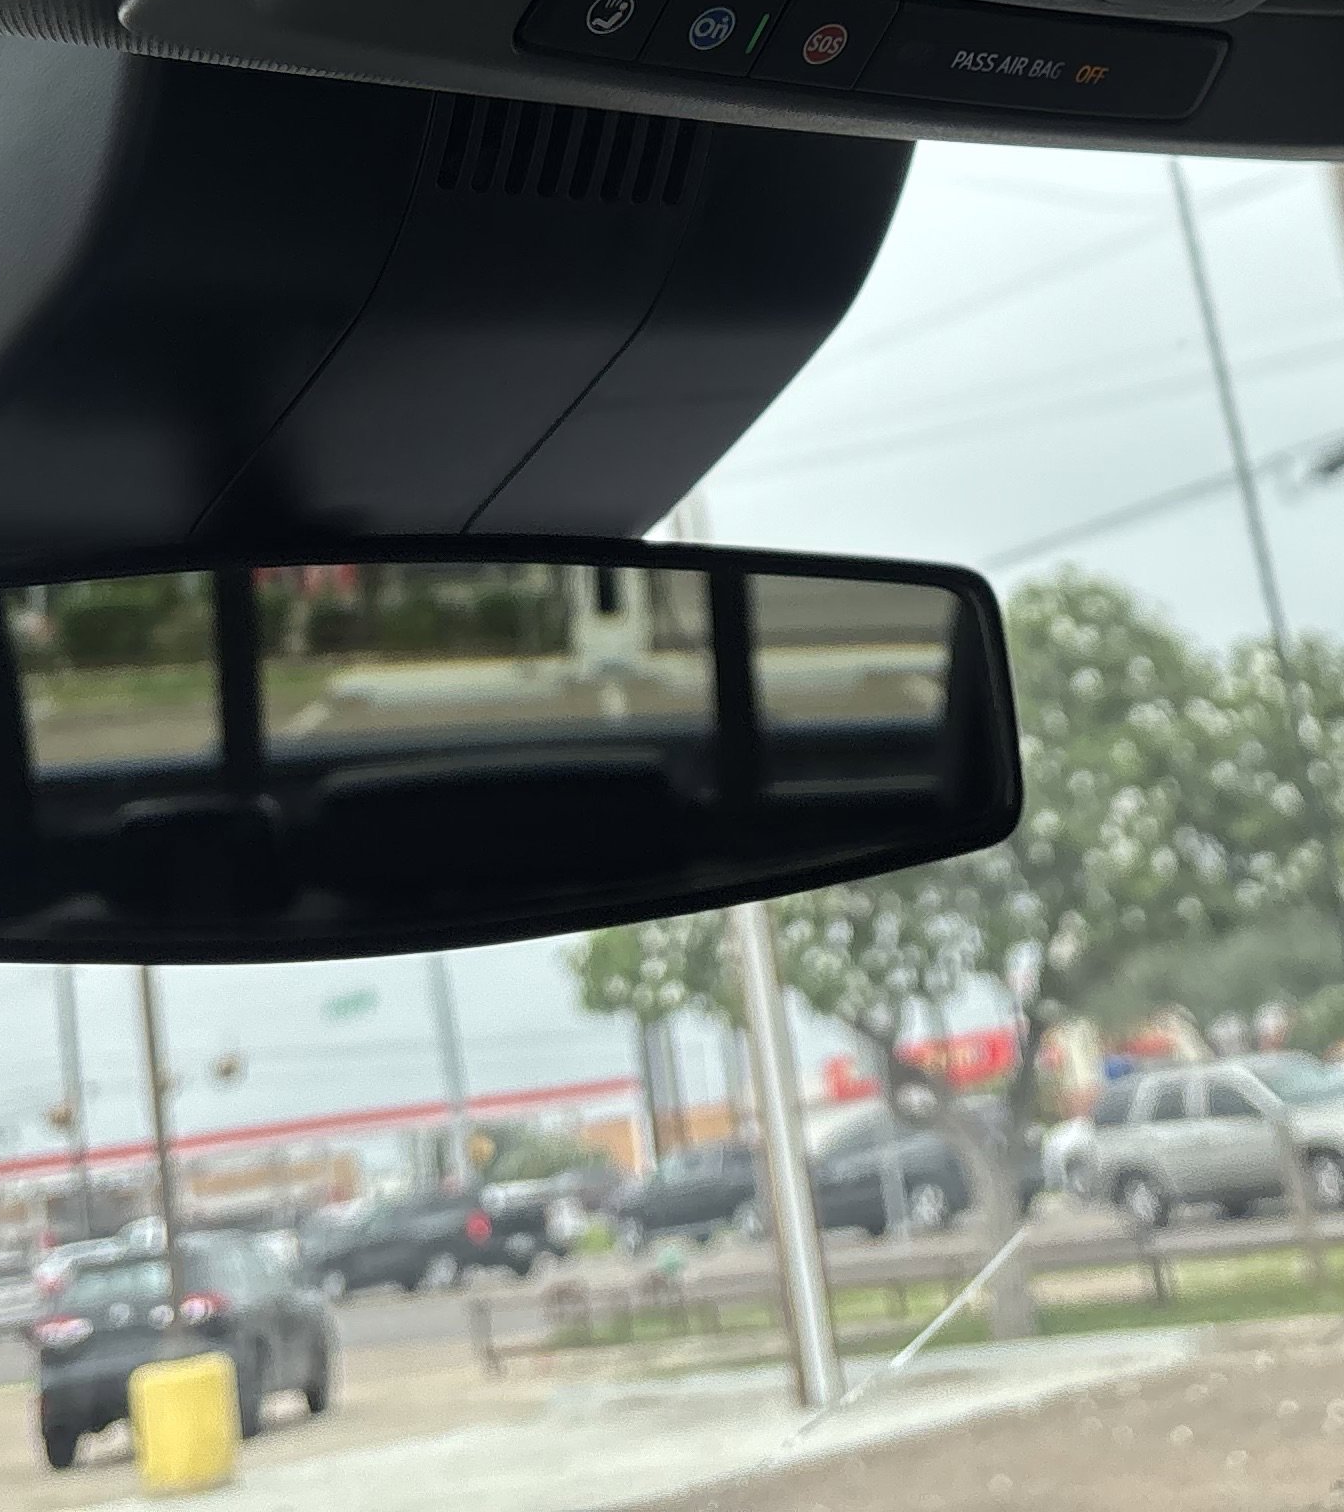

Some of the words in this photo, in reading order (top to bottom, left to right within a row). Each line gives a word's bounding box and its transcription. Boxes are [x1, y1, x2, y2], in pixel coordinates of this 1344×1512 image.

[694, 16, 729, 39] On
[807, 34, 843, 54] SOS
[950, 50, 999, 72] PASS
[995, 55, 1029, 76] AIR
[1027, 59, 1066, 80] BAG
[1074, 64, 1110, 85] OFF
